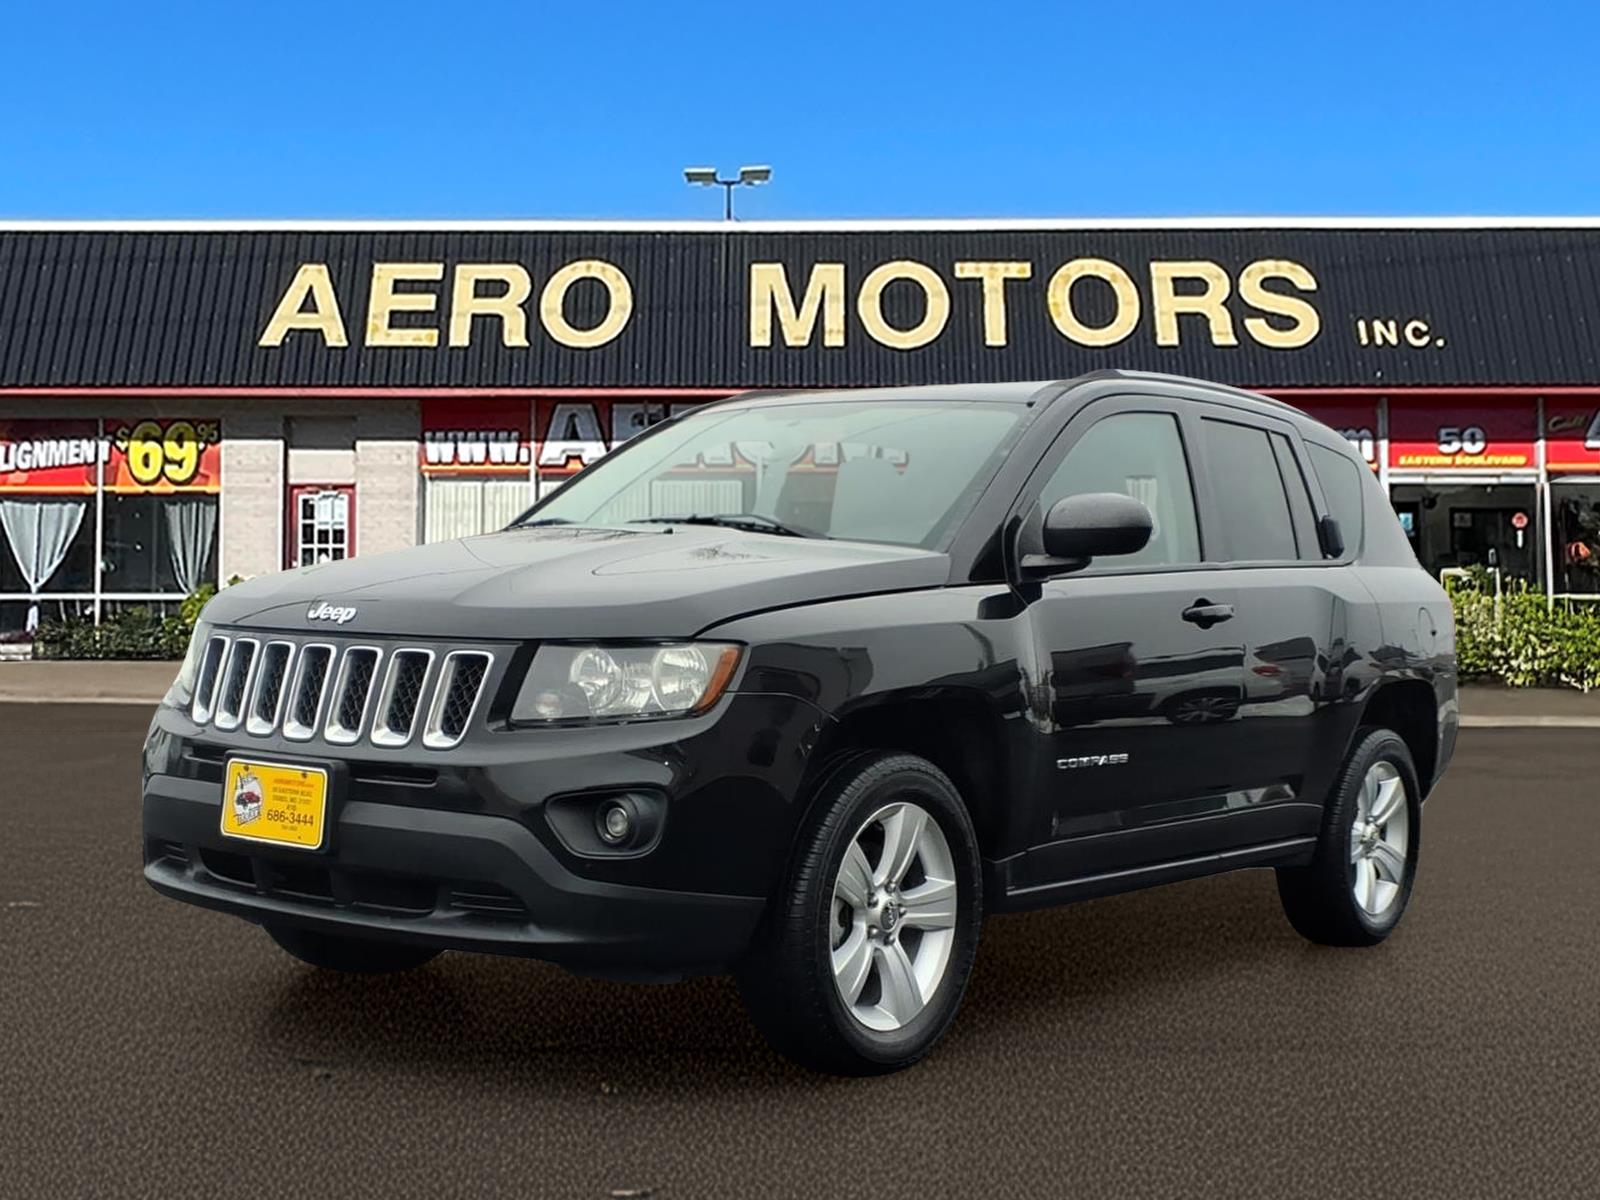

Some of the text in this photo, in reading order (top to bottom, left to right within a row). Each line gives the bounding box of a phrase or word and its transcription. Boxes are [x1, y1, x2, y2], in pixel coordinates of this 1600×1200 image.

[258, 259, 1444, 348] AERO MOTORS INC.
[1438, 427, 1486, 454] 50
[307, 602, 357, 625] Jeep
[1056, 753, 1129, 769] COMPASS
[266, 809, 315, 827] 686-3444
